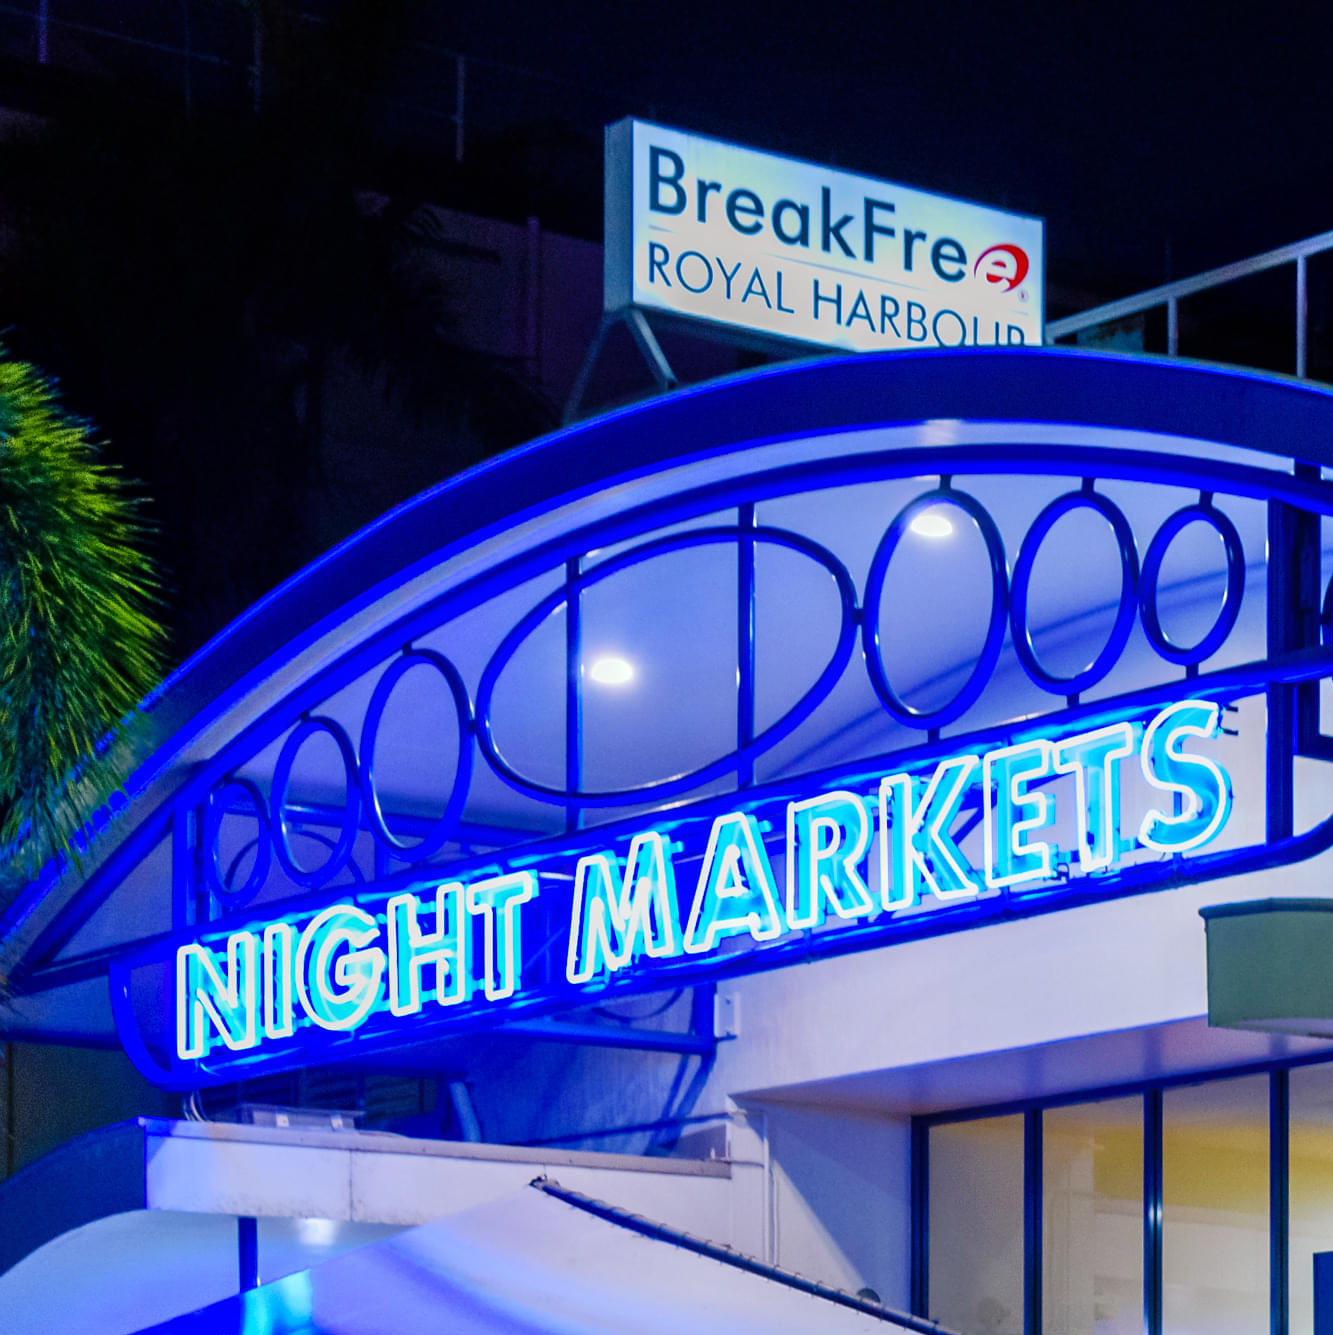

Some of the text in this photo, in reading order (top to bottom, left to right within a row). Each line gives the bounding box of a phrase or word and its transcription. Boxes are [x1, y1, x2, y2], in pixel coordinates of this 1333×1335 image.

[649, 145, 1029, 293] BreakFree
[649, 241, 795, 314] ROYAL
[176, 700, 1234, 1061] NIGHT MARKETS
